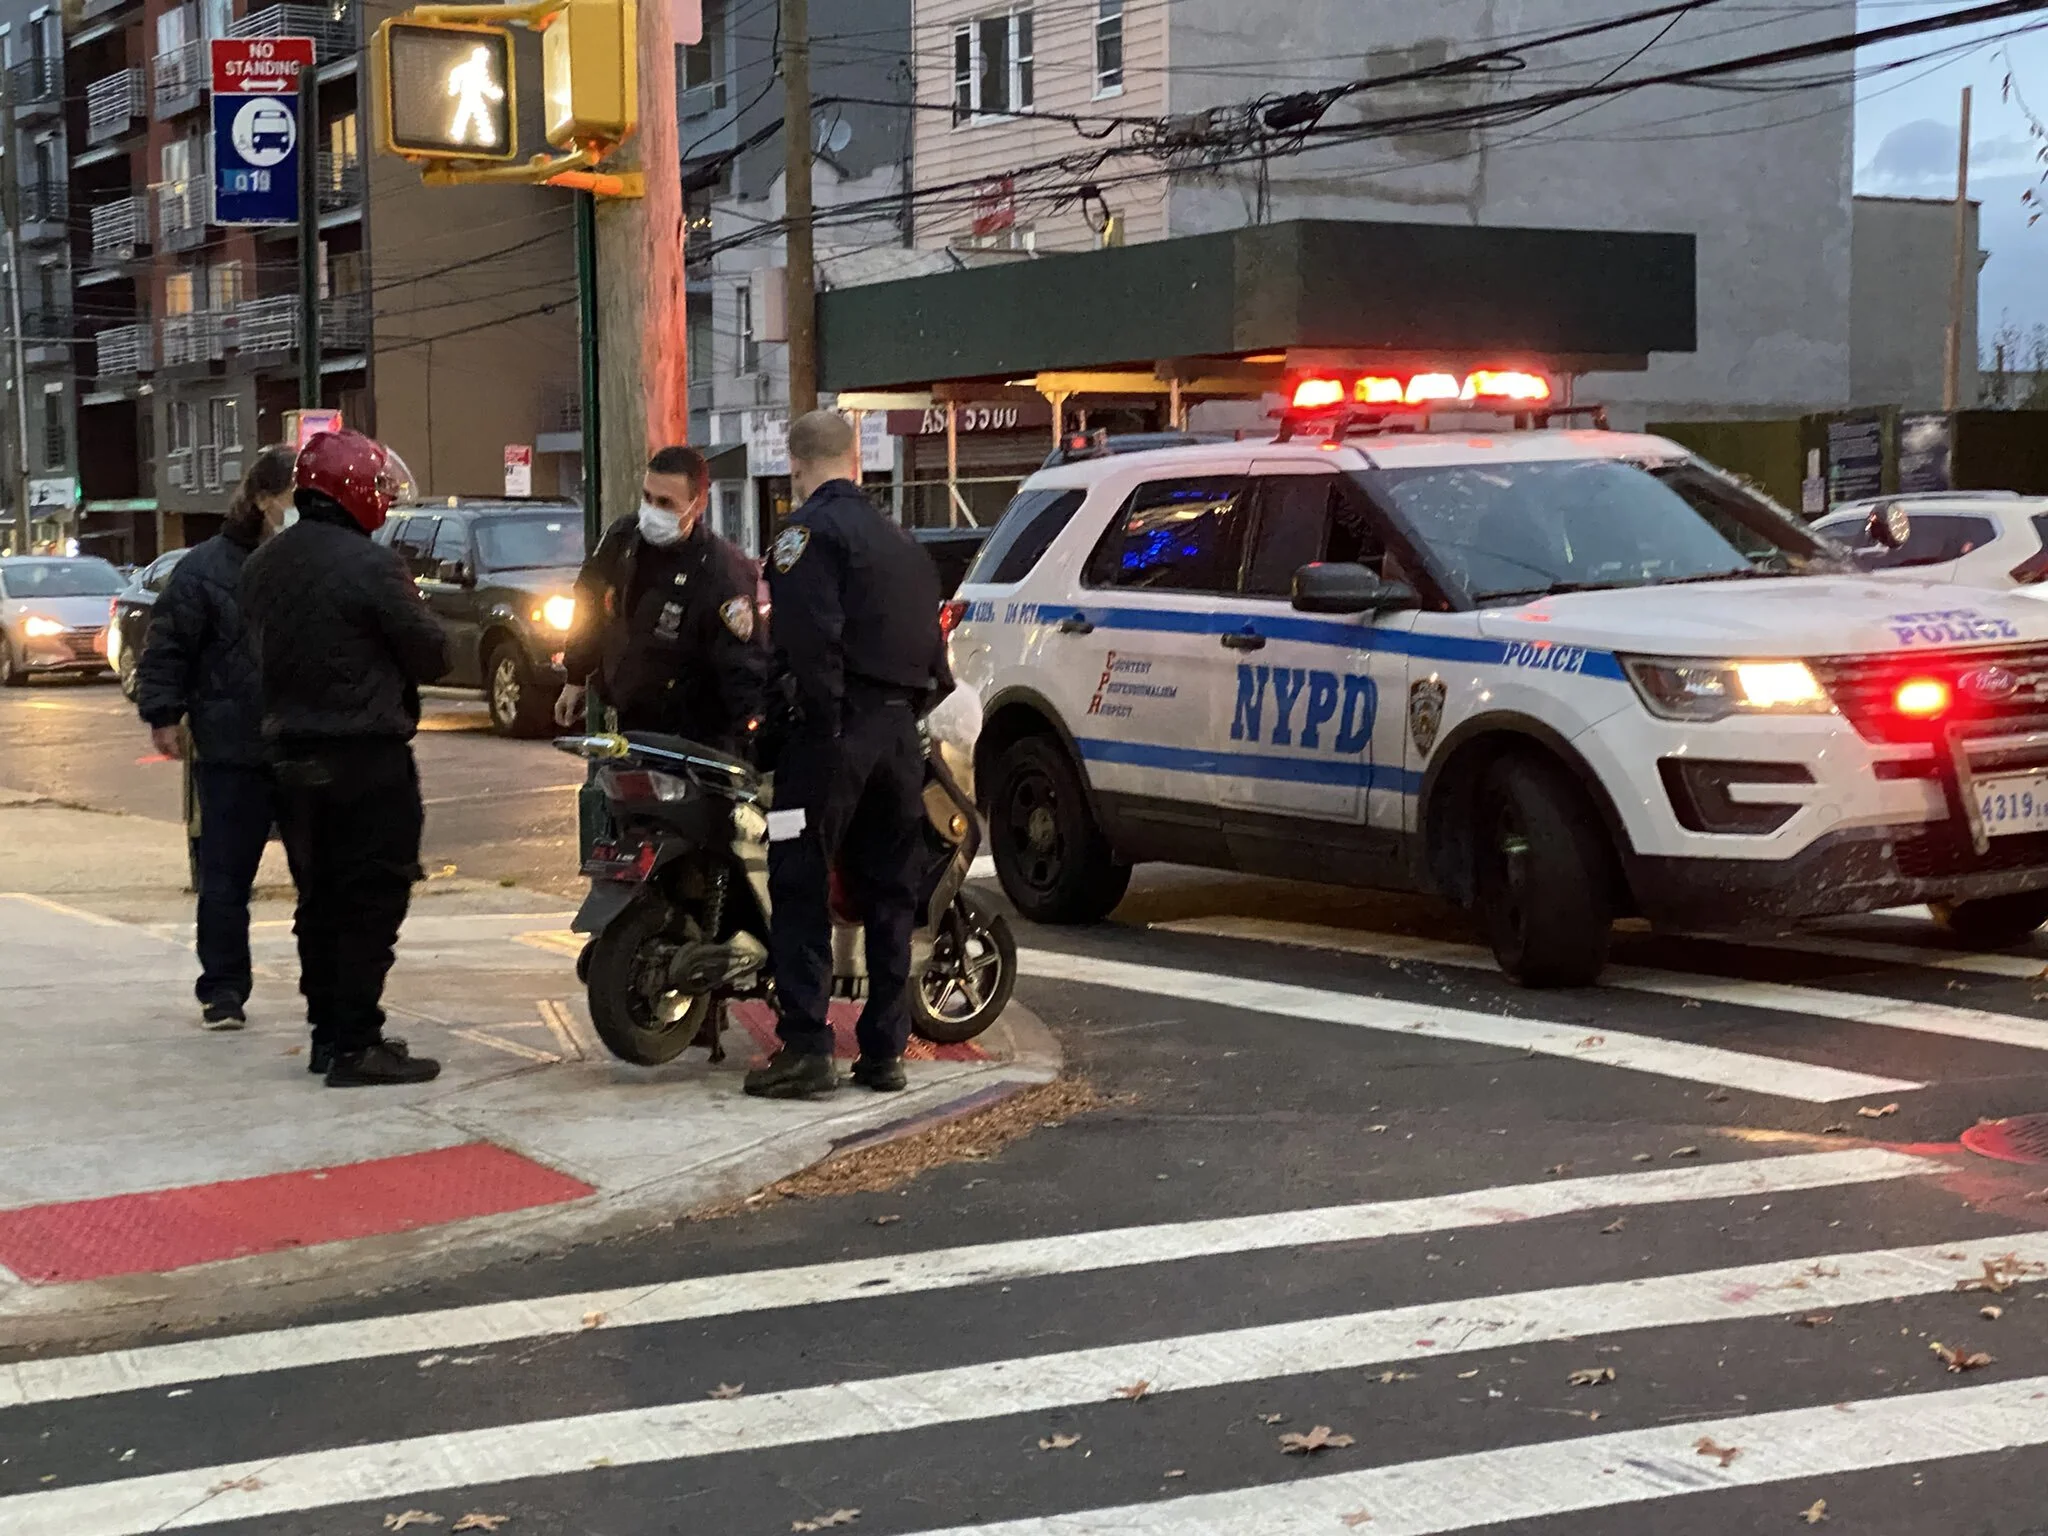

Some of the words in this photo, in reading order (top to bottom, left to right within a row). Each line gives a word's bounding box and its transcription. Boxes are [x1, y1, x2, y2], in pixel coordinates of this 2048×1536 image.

[248, 43, 275, 59] NO
[225, 61, 300, 76] STANDING
[1892, 619, 2018, 644] POLICE
[1502, 641, 1585, 674] POLICE
[1230, 664, 1379, 755] NYPD
